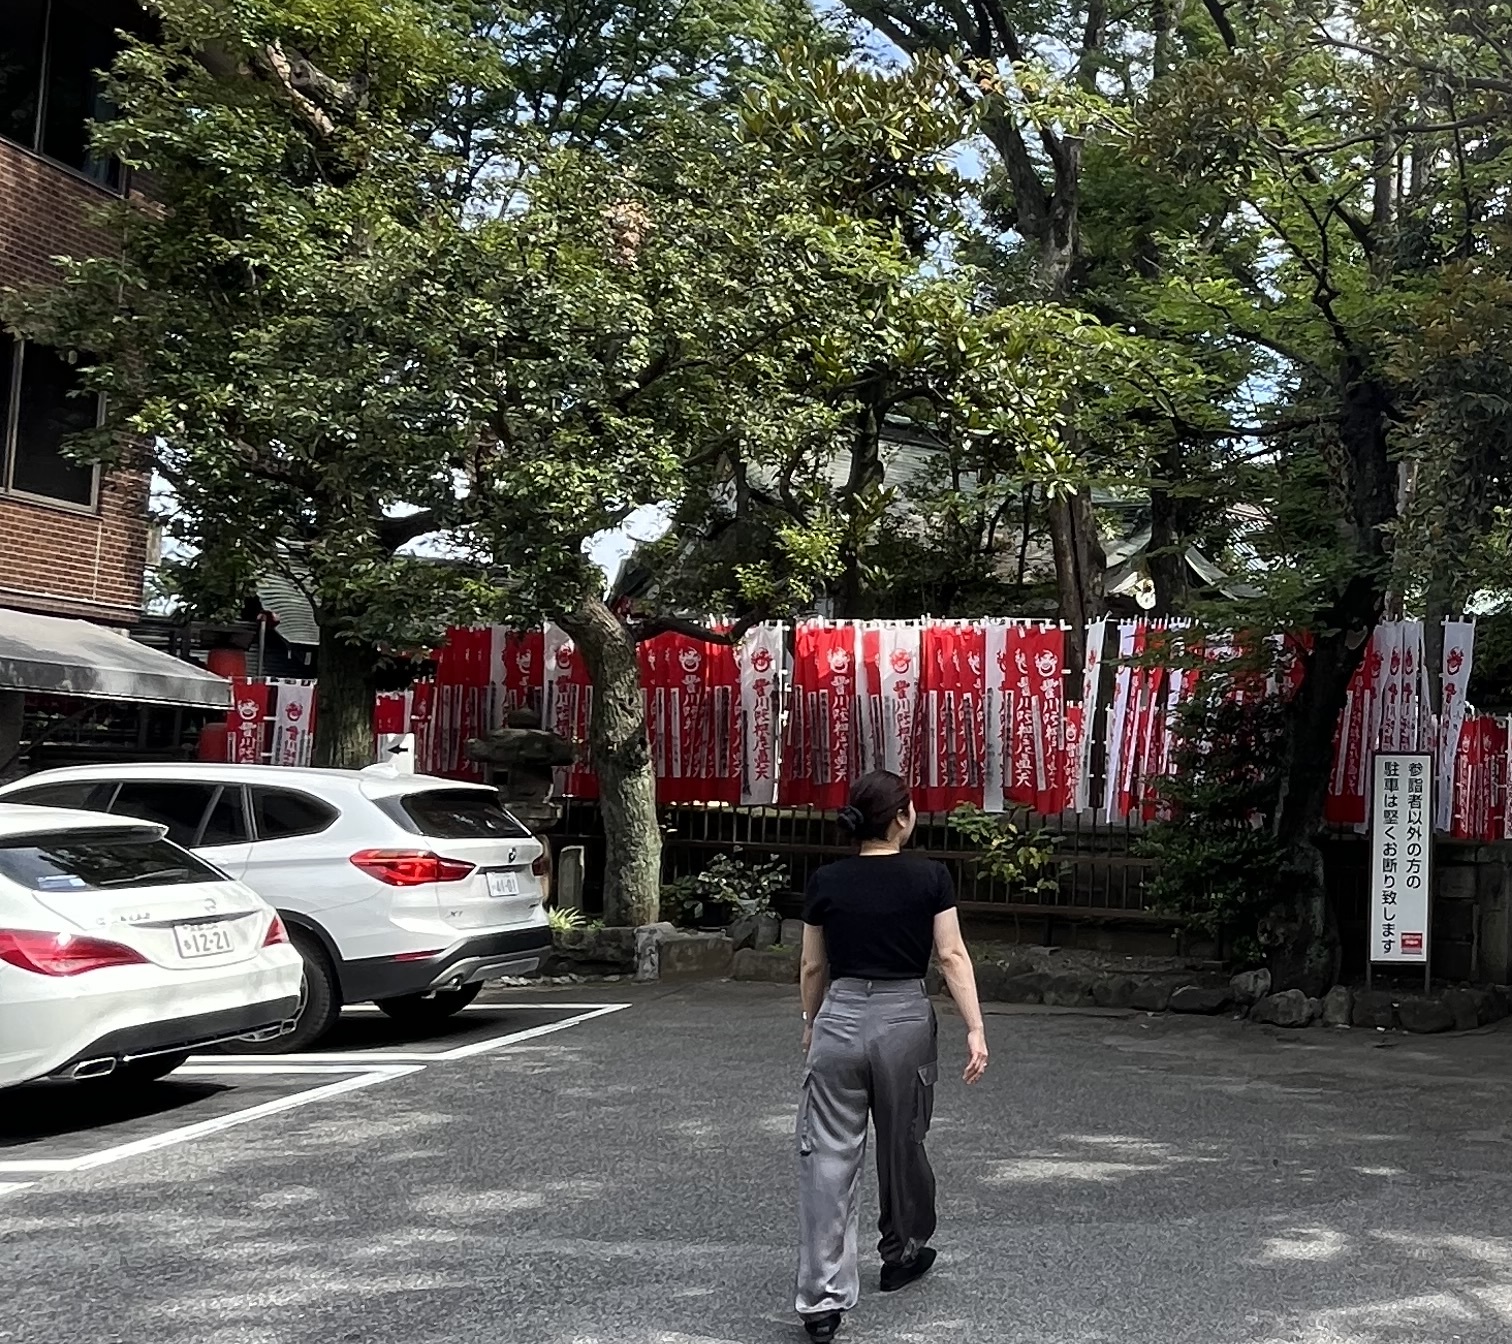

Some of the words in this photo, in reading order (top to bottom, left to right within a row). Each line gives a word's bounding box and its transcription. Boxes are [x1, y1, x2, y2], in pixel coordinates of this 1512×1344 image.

[1381, 761, 1400, 954] 駐車は堅くお断り致します
[1406, 762, 1423, 889] 参詣者以外の方の
